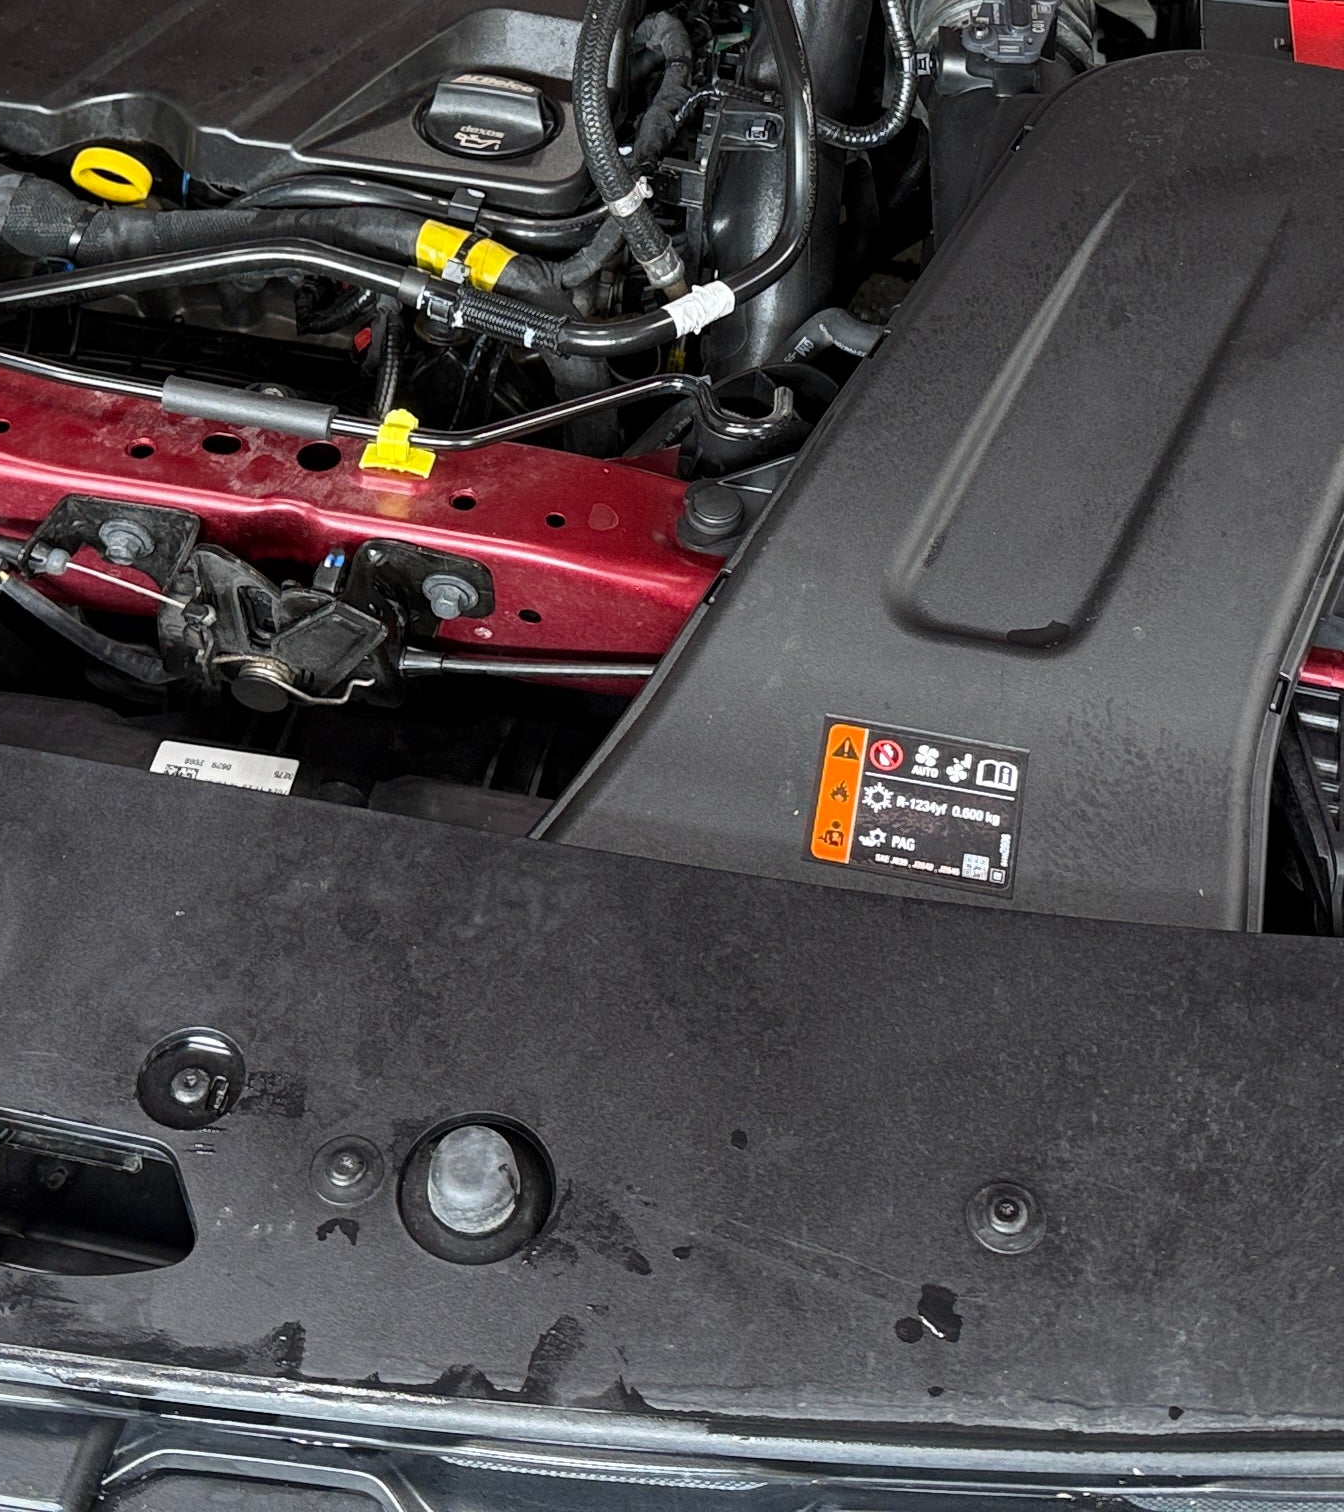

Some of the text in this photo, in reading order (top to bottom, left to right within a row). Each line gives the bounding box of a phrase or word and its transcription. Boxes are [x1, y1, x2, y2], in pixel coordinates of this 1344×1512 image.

[460, 125, 505, 139] dexos
[911, 764, 939, 779] AUTO
[896, 795, 1001, 827] R-1234yf 0.600 kg
[891, 836, 916, 852] PAG
